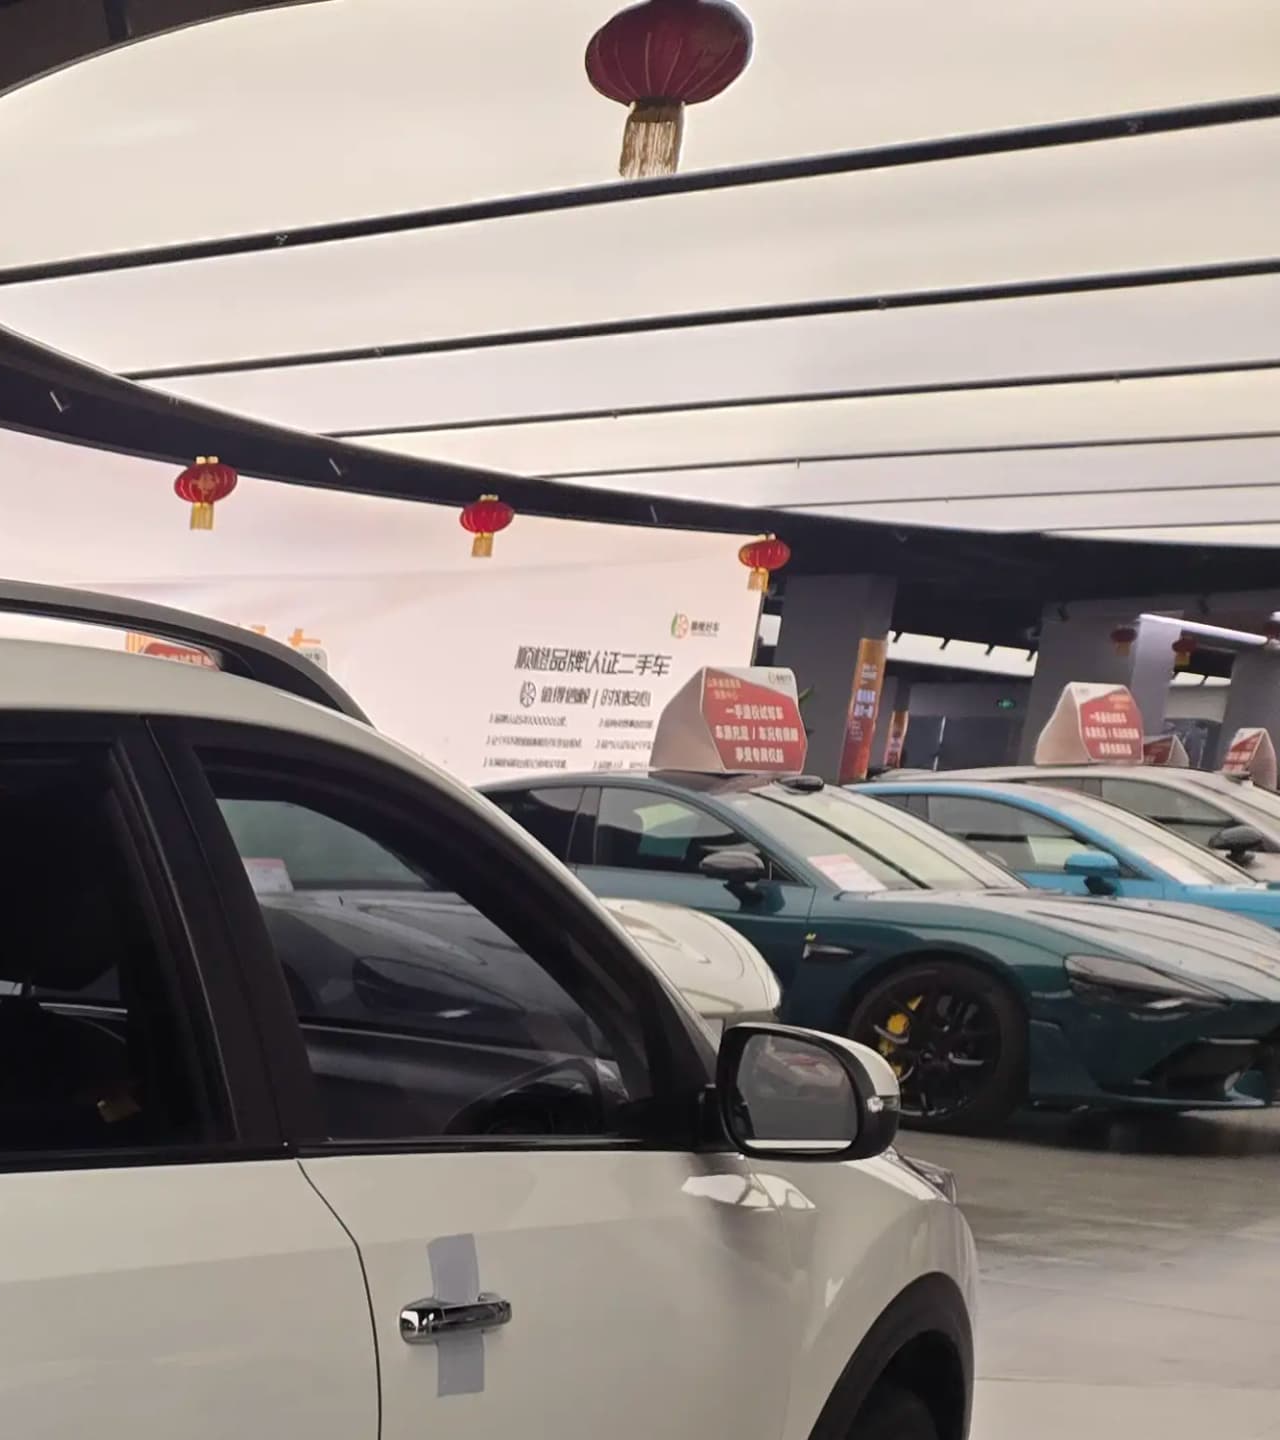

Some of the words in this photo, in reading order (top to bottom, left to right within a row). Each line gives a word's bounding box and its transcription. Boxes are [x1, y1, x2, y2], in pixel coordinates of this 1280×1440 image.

[514, 645, 673, 677] 顺橙品牌认证二手车
